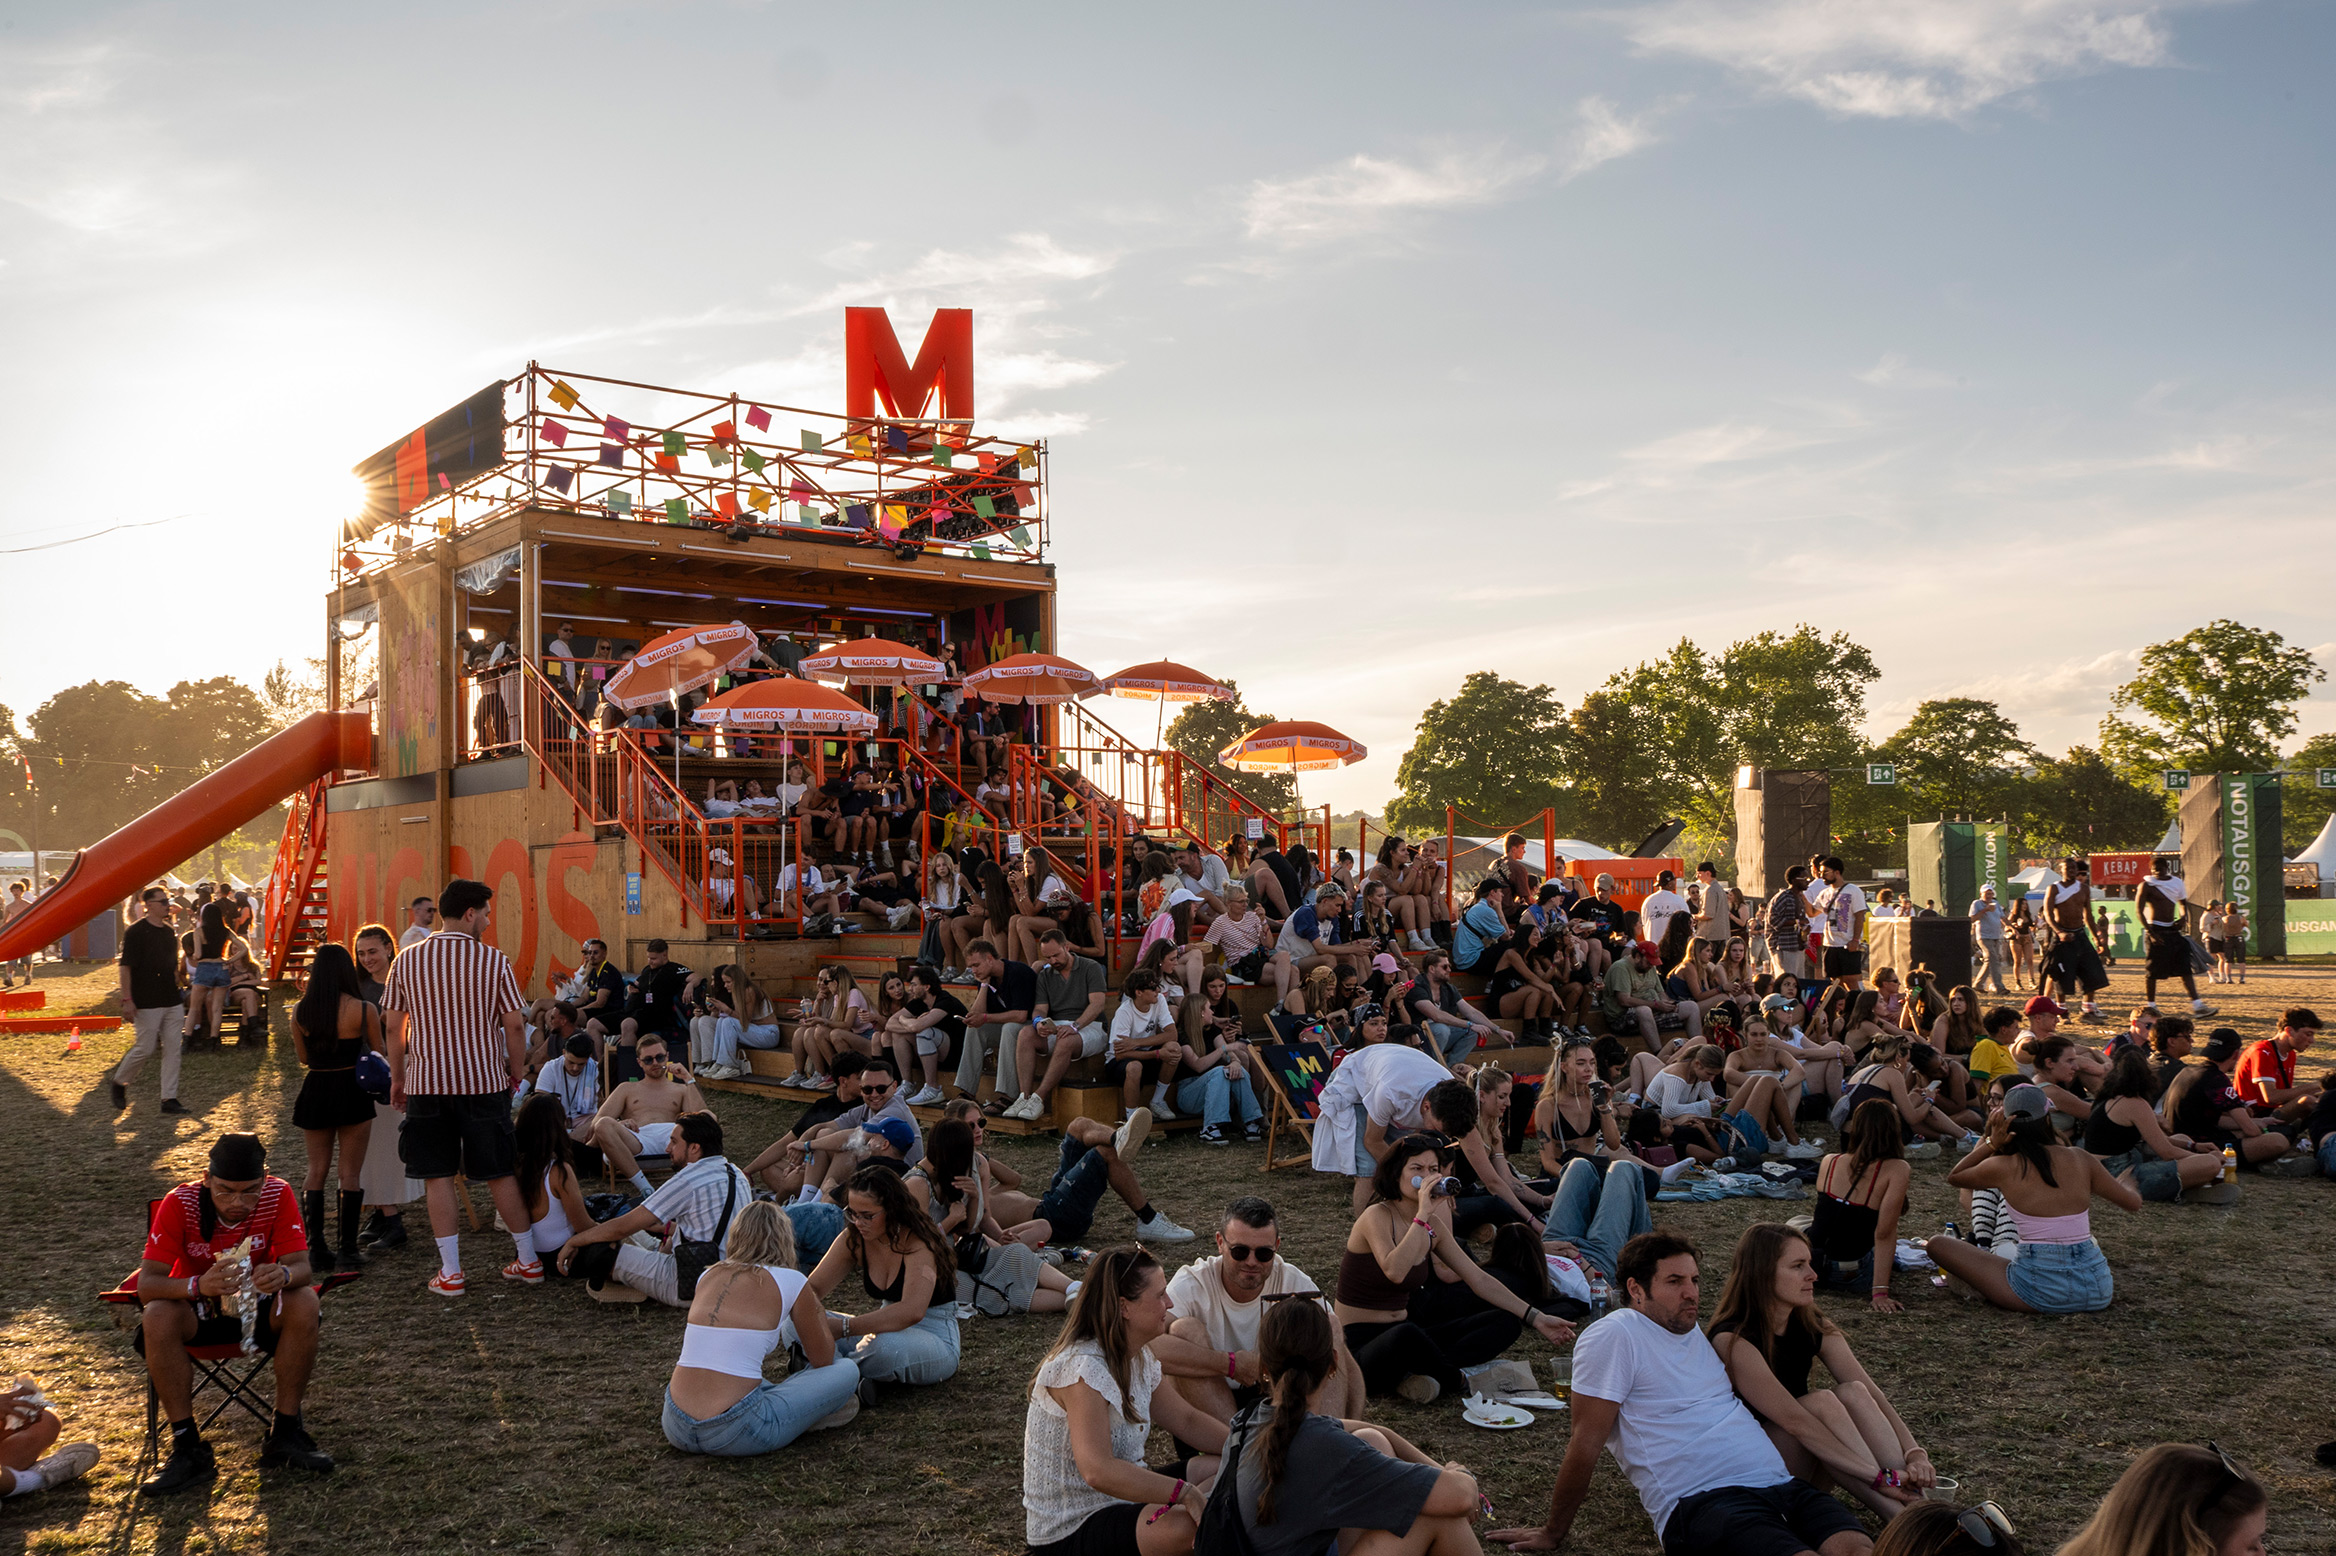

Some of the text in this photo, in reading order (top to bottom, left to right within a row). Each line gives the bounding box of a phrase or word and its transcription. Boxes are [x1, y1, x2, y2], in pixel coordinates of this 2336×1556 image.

[845, 306, 974, 422] M
[706, 629, 738, 642] MIGROS
[648, 642, 686, 663] MIGROS
[806, 659, 831, 669] MIGROS
[851, 658, 888, 666] MIGROS
[909, 660, 936, 670] MIGROS
[1001, 668, 1034, 676] MIGROS
[1054, 669, 1084, 679] MIGROS
[1124, 680, 1155, 688] MIGROS
[1176, 684, 1207, 692] MIGROS
[743, 711, 785, 720] MIGROS
[812, 712, 851, 721] MIGROS
[1255, 739, 1289, 750] MIGROS
[1308, 739, 1341, 749] MIGROS
[2103, 861, 2138, 876] KEBAP
